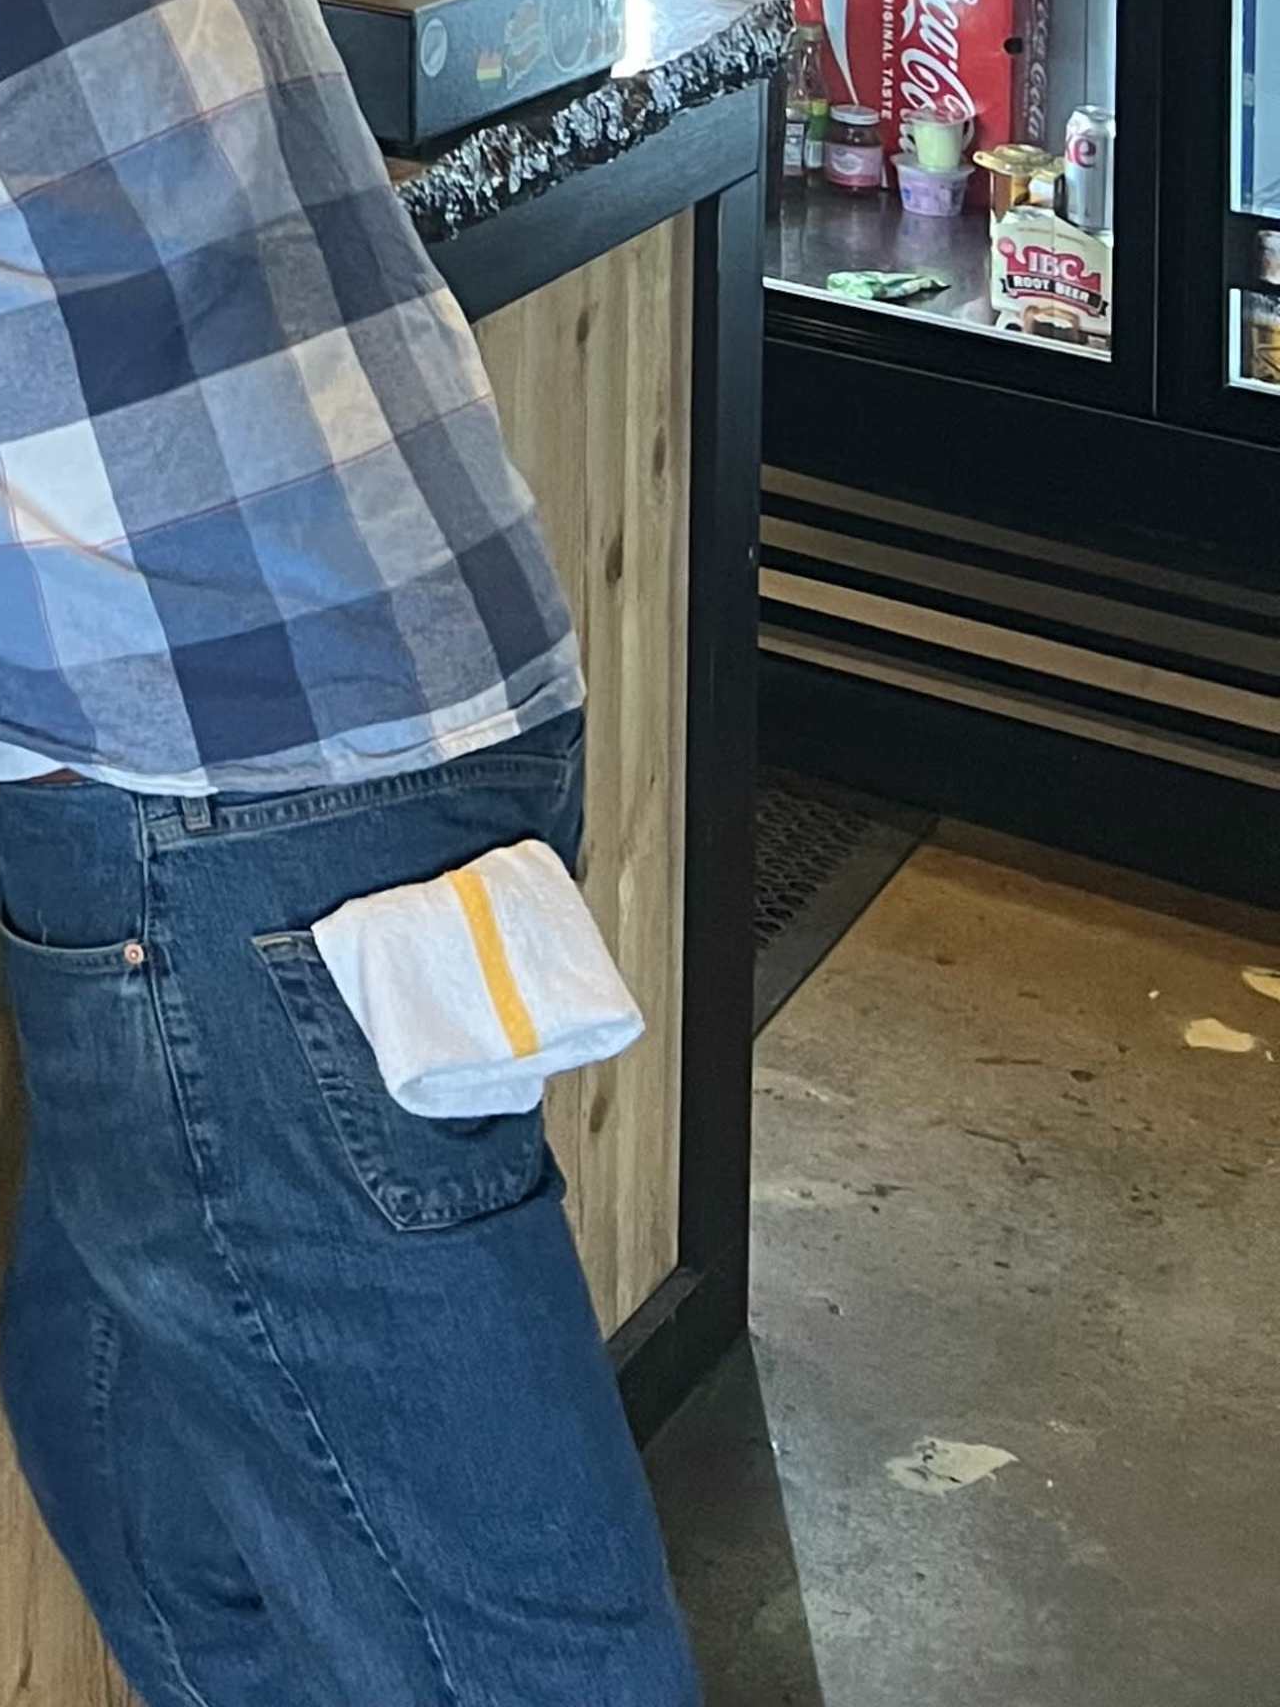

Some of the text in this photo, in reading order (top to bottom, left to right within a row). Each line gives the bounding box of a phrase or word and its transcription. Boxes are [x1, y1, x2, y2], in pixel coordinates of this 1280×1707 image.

[881, 69, 894, 120] TASTE
[1028, 250, 1079, 281] IBC
[1013, 275, 1090, 304] ROOT BEER
